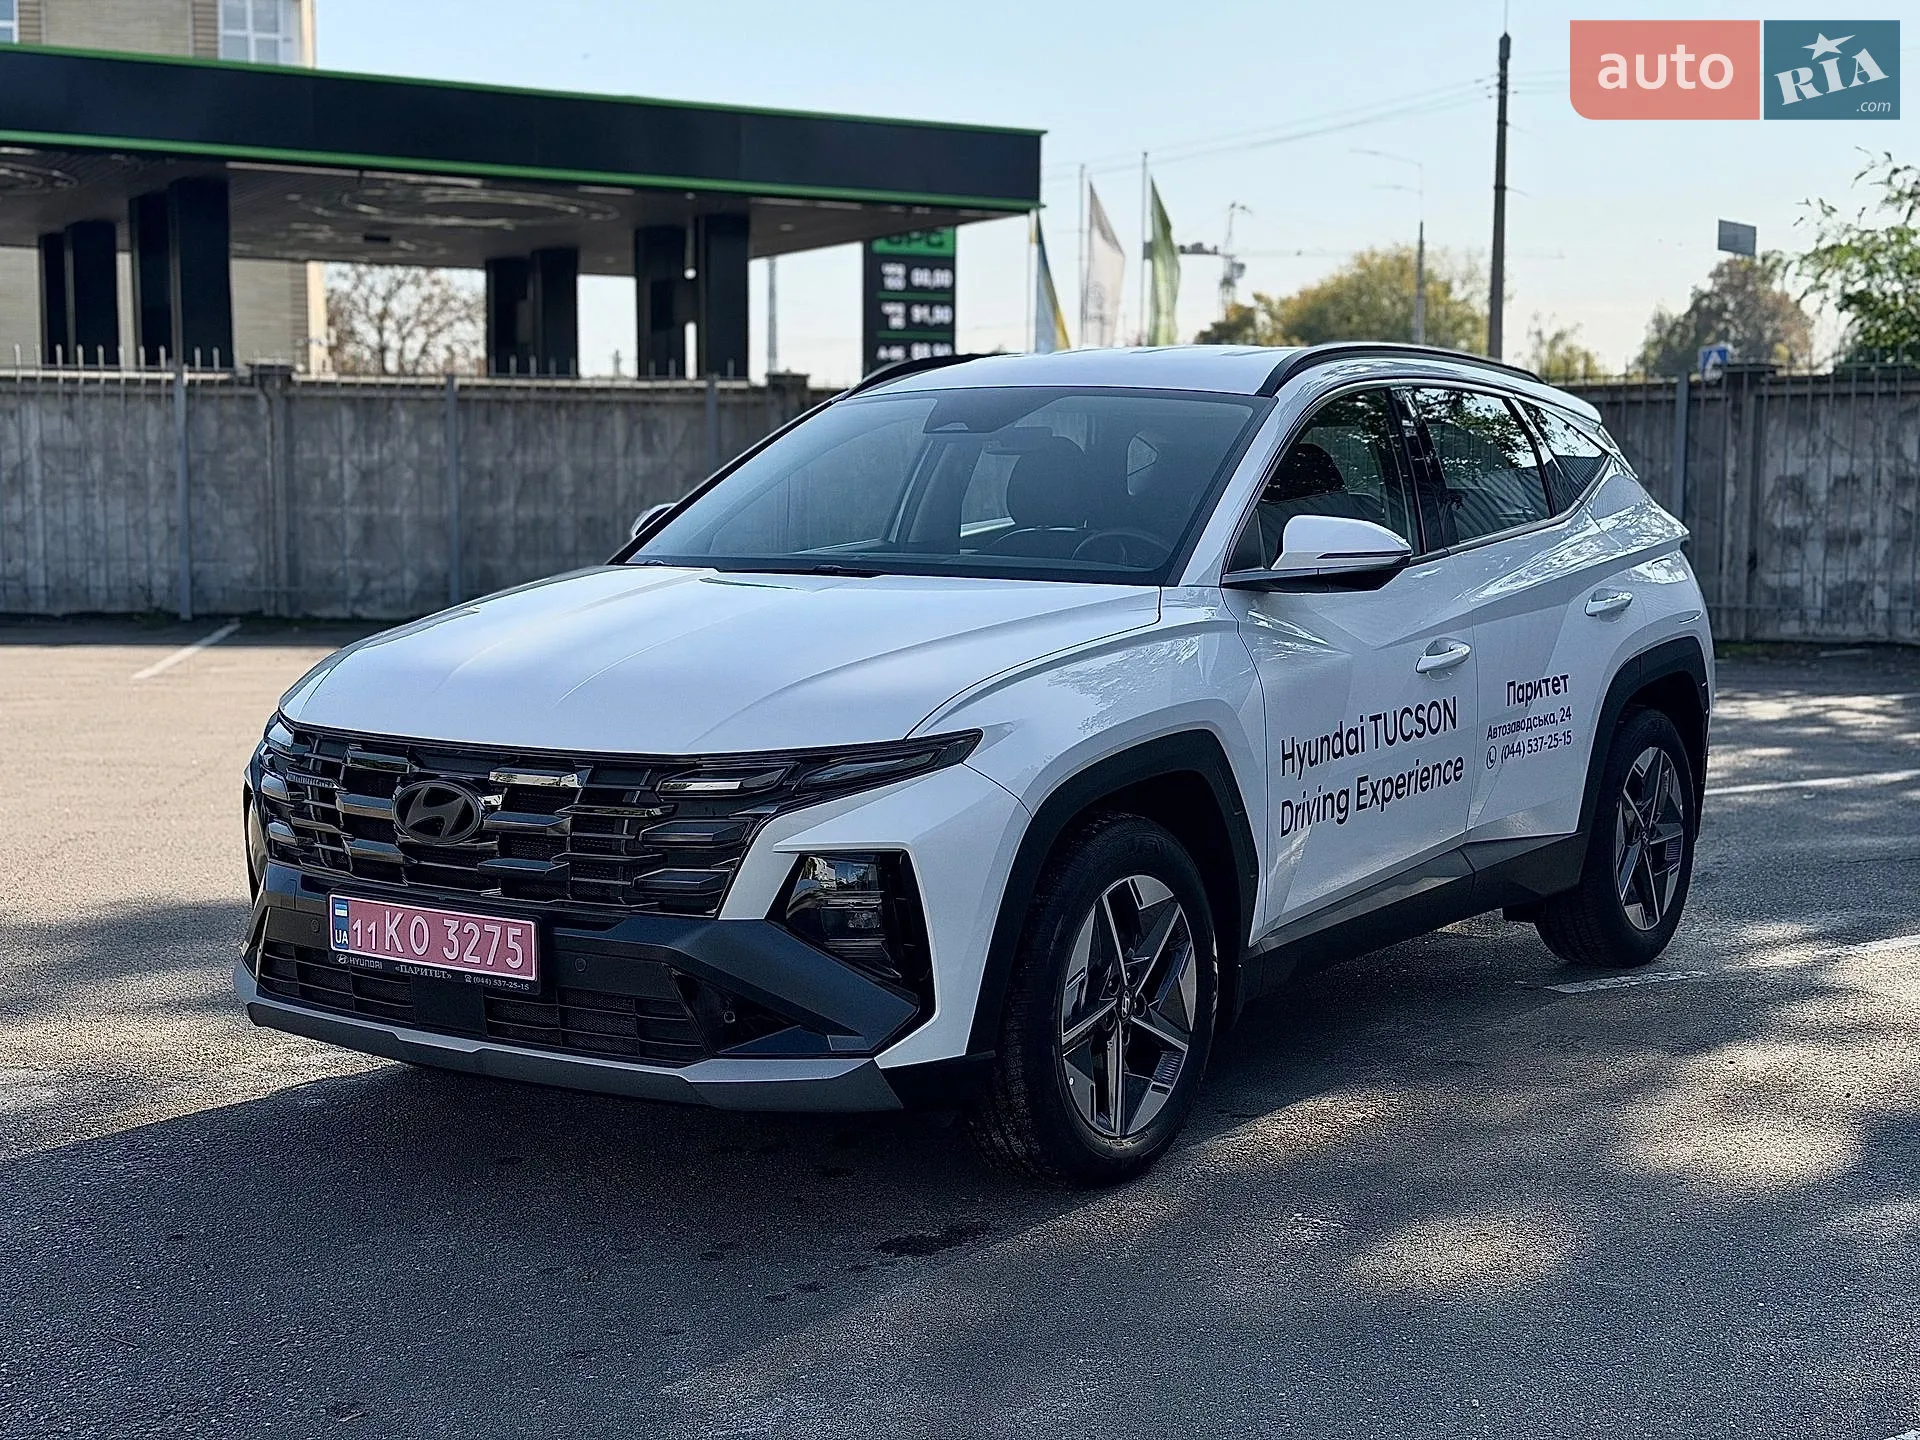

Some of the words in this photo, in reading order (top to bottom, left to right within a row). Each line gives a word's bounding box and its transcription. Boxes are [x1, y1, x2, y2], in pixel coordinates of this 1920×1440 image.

[1507, 674, 1570, 707] Паритет
[1280, 714, 1366, 780] Hyundai
[1369, 696, 1458, 750] TUCSON
[1486, 713, 1558, 741] Автозаводська,
[1559, 706, 1572, 722] 24
[1501, 744, 1526, 764] (044)
[1527, 730, 1572, 755] 537-25-15
[1280, 784, 1350, 838] Driving
[1356, 755, 1464, 813] Experience
[335, 929, 348, 945] UA
[443, 918, 523, 969] 3275
[350, 958, 383, 969] HYUNDAI
[395, 964, 452, 979] «ПАРИТЕТ»
[473, 976, 492, 987] (044)
[493, 978, 529, 990] 537-25-15
